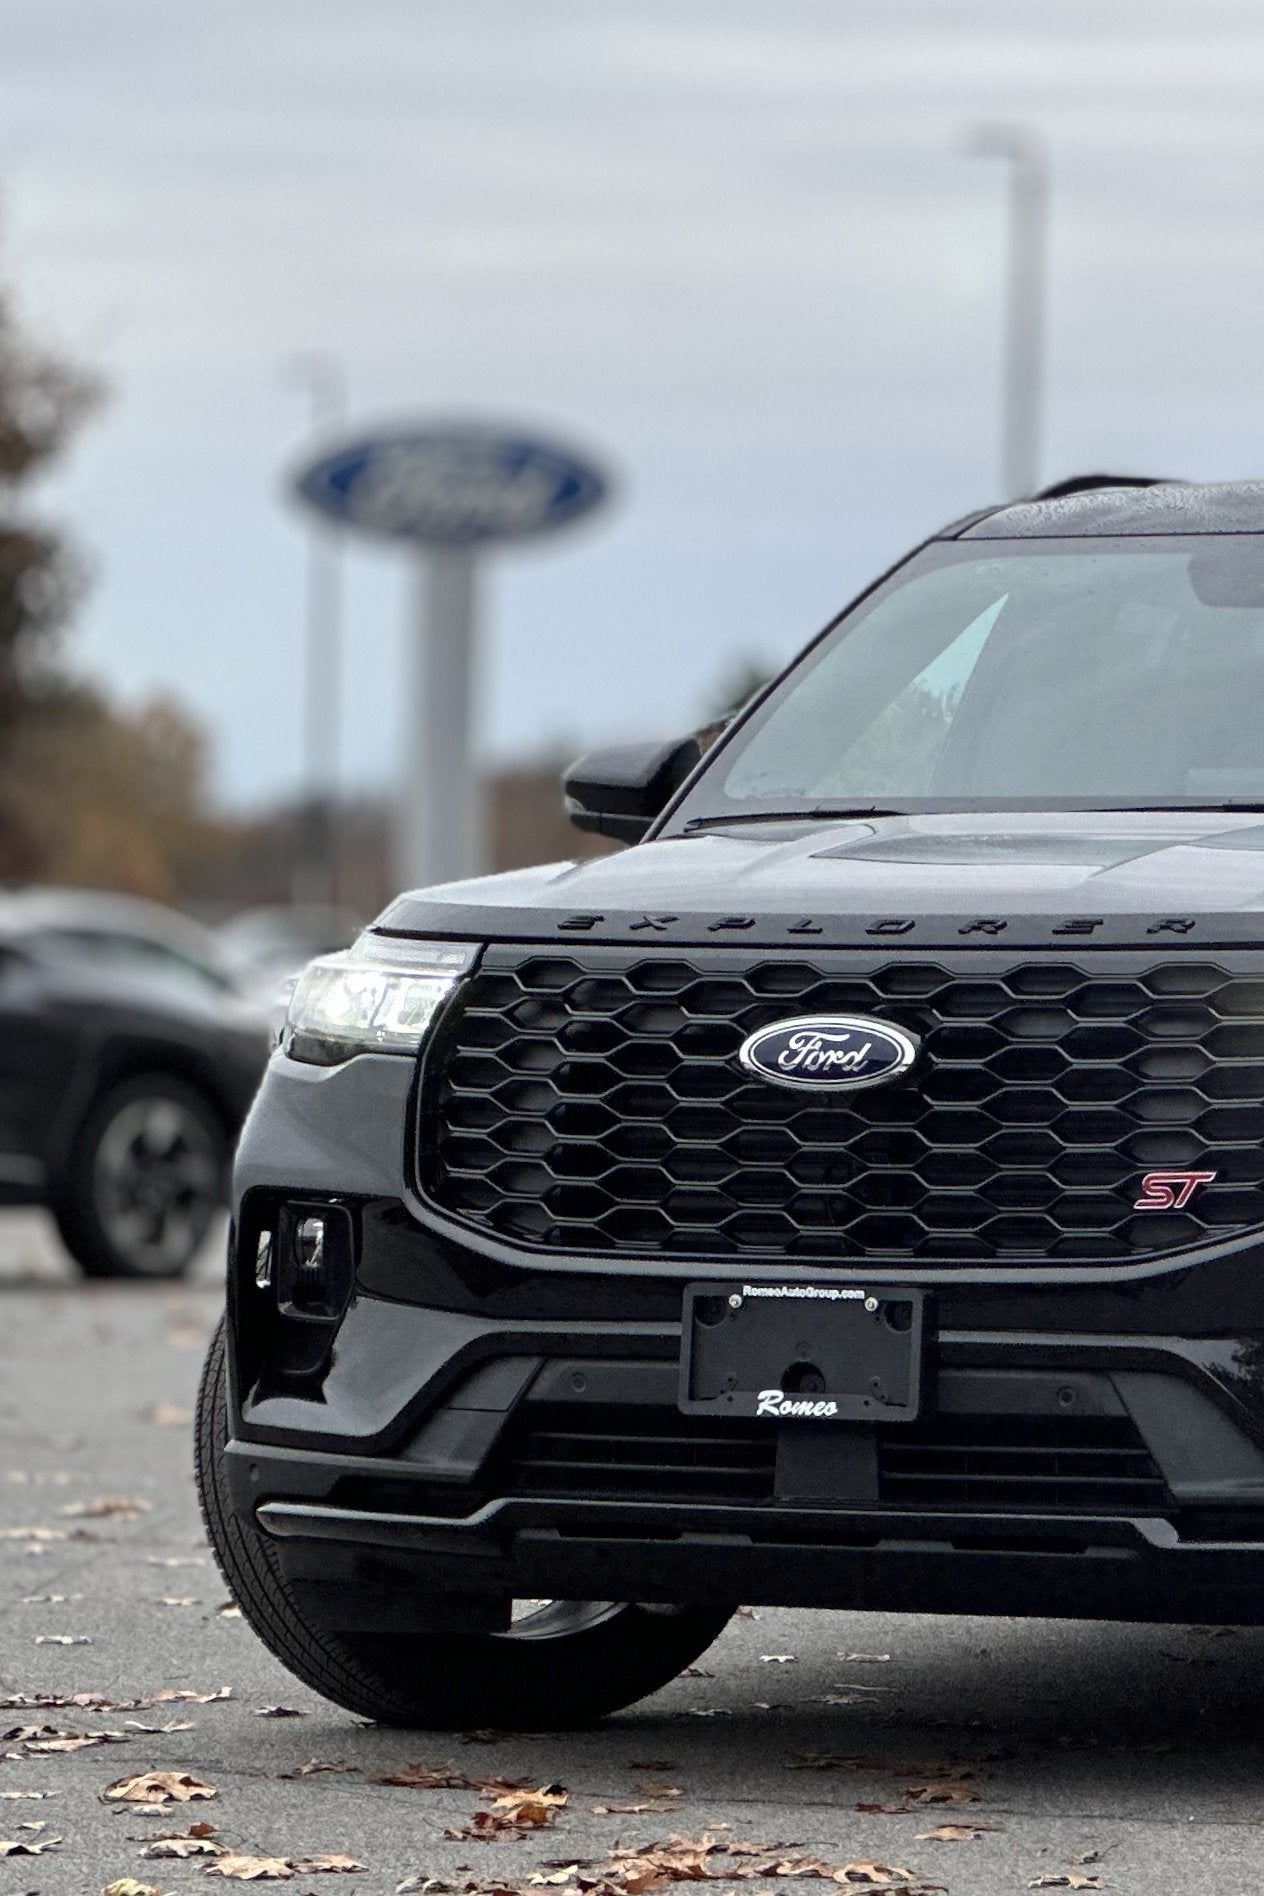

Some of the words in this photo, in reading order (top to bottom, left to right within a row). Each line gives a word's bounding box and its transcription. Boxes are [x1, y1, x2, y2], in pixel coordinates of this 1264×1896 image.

[557, 915, 1197, 935] EXPLORER
[777, 1031, 872, 1072] Ford
[1133, 1171, 1217, 1209] ST
[742, 1285, 865, 1300] RomeoAutoGroup.com
[756, 1389, 838, 1417] Romeo
